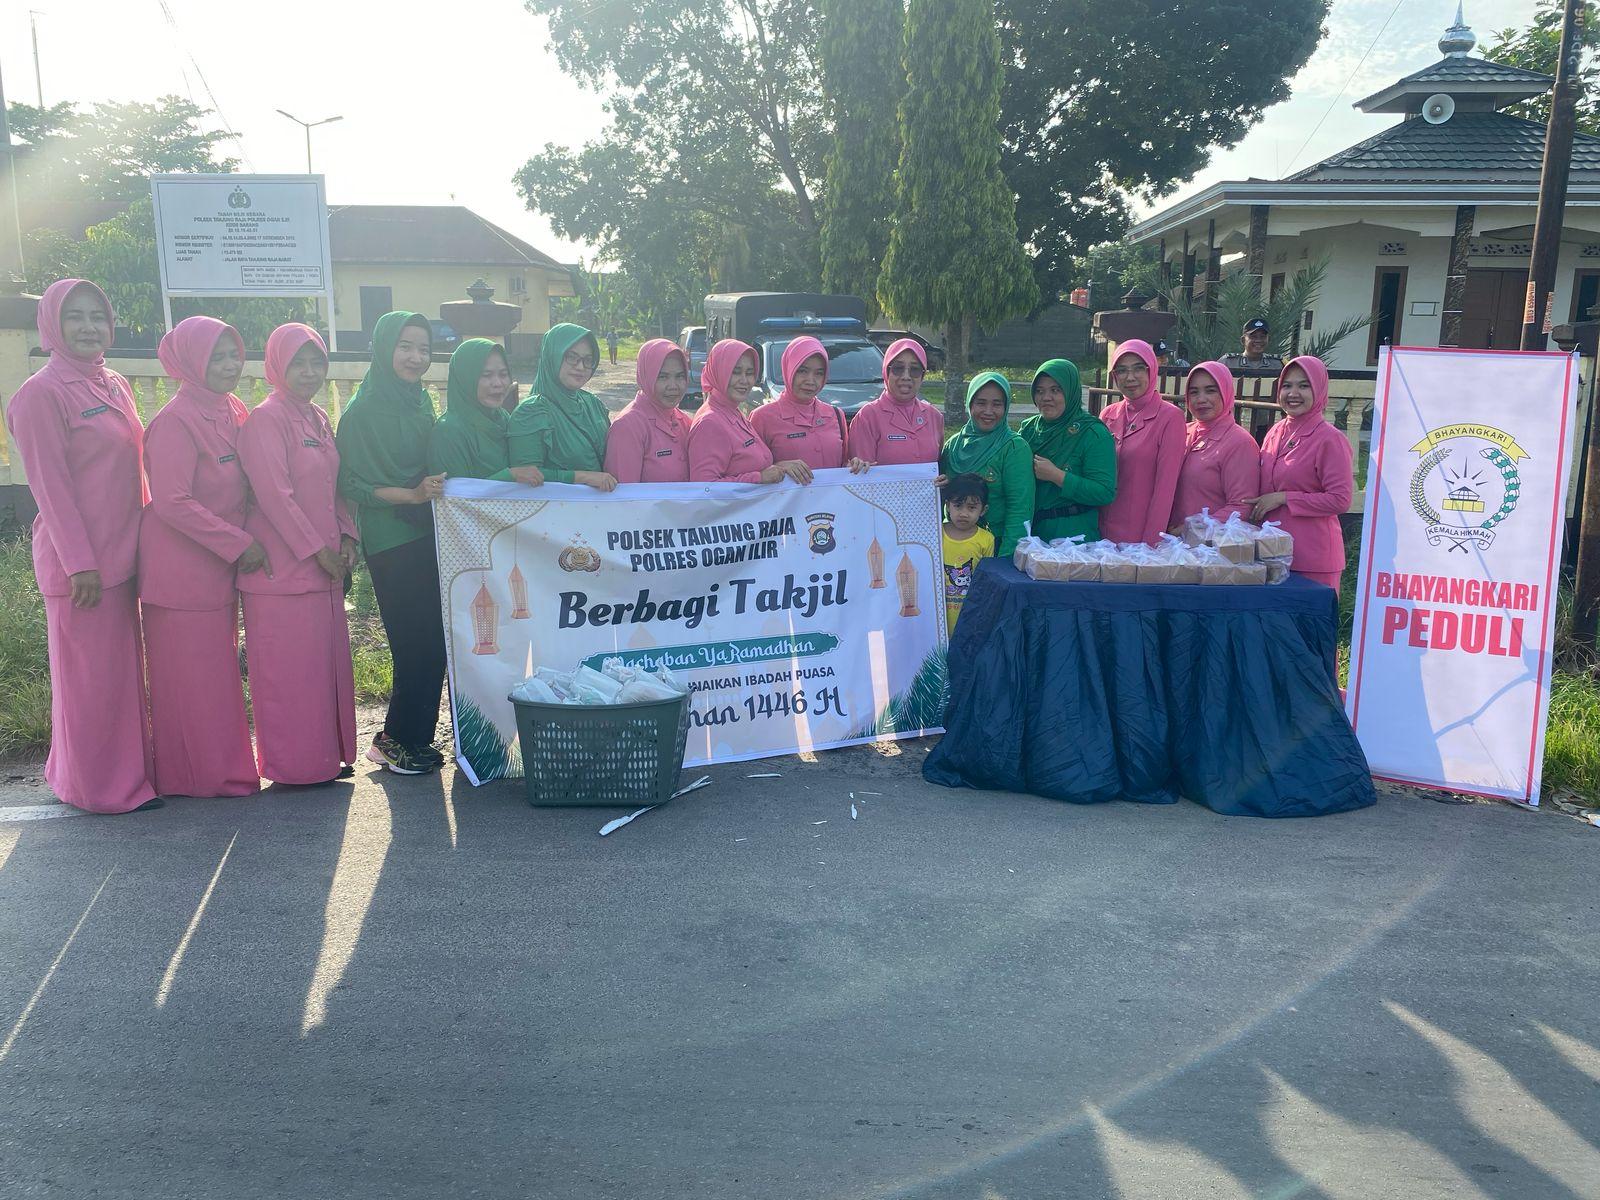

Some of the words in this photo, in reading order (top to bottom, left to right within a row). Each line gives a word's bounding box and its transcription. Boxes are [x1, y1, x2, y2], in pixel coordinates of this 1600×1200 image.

[1434, 427, 1507, 443] BHAYANGKARI
[607, 528, 676, 551] POLSEK
[677, 522, 756, 547] TANJUNG
[758, 516, 796, 539] RAJA
[1427, 526, 1459, 537] KEMALA
[1460, 527, 1491, 540] HIKMAH
[630, 549, 698, 572] POLRES
[701, 545, 747, 568] OGAN
[747, 540, 779, 561] ILIR
[558, 583, 721, 630] Berbagi
[729, 569, 849, 618] Takjil
[1376, 571, 1539, 612] BHAYANGKARI
[1382, 605, 1524, 658] PEDULI
[745, 670, 792, 686] IBADAH
[796, 666, 835, 680] PUASA
[743, 689, 808, 721] 1446
[813, 685, 848, 717] H
